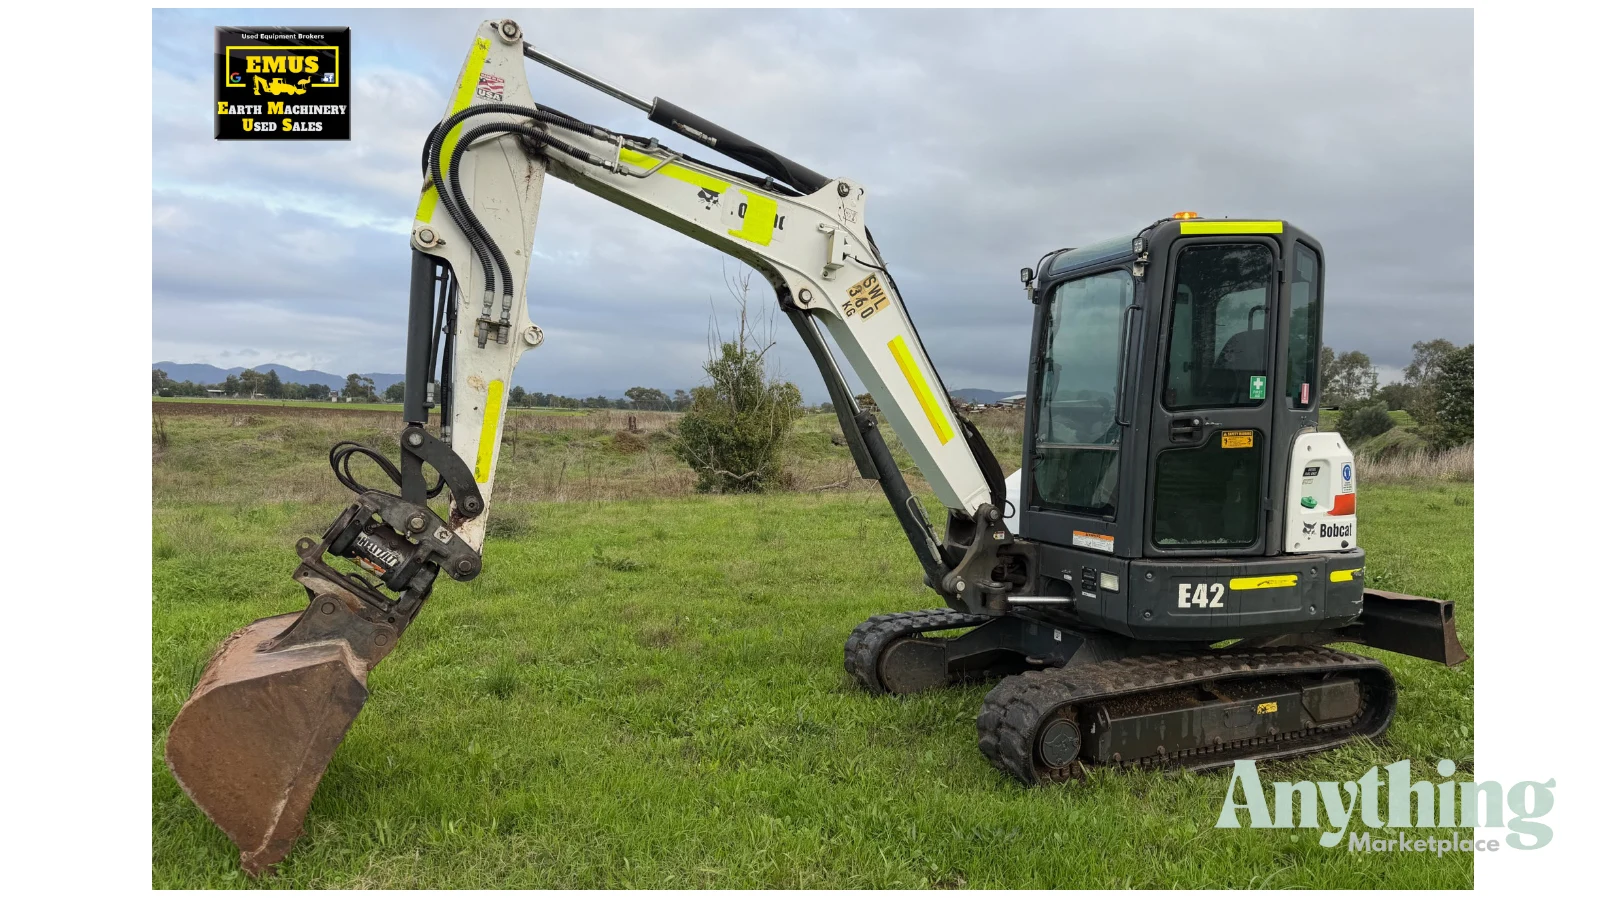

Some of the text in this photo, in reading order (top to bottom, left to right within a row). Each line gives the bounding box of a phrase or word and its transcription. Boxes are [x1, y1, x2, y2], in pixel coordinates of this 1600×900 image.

[478, 88, 501, 101] USA
[849, 285, 875, 319] 360
[863, 275, 886, 310] SWL
[842, 300, 856, 318] KG
[1319, 523, 1352, 538] Bobcat
[1177, 582, 1225, 608] E42
